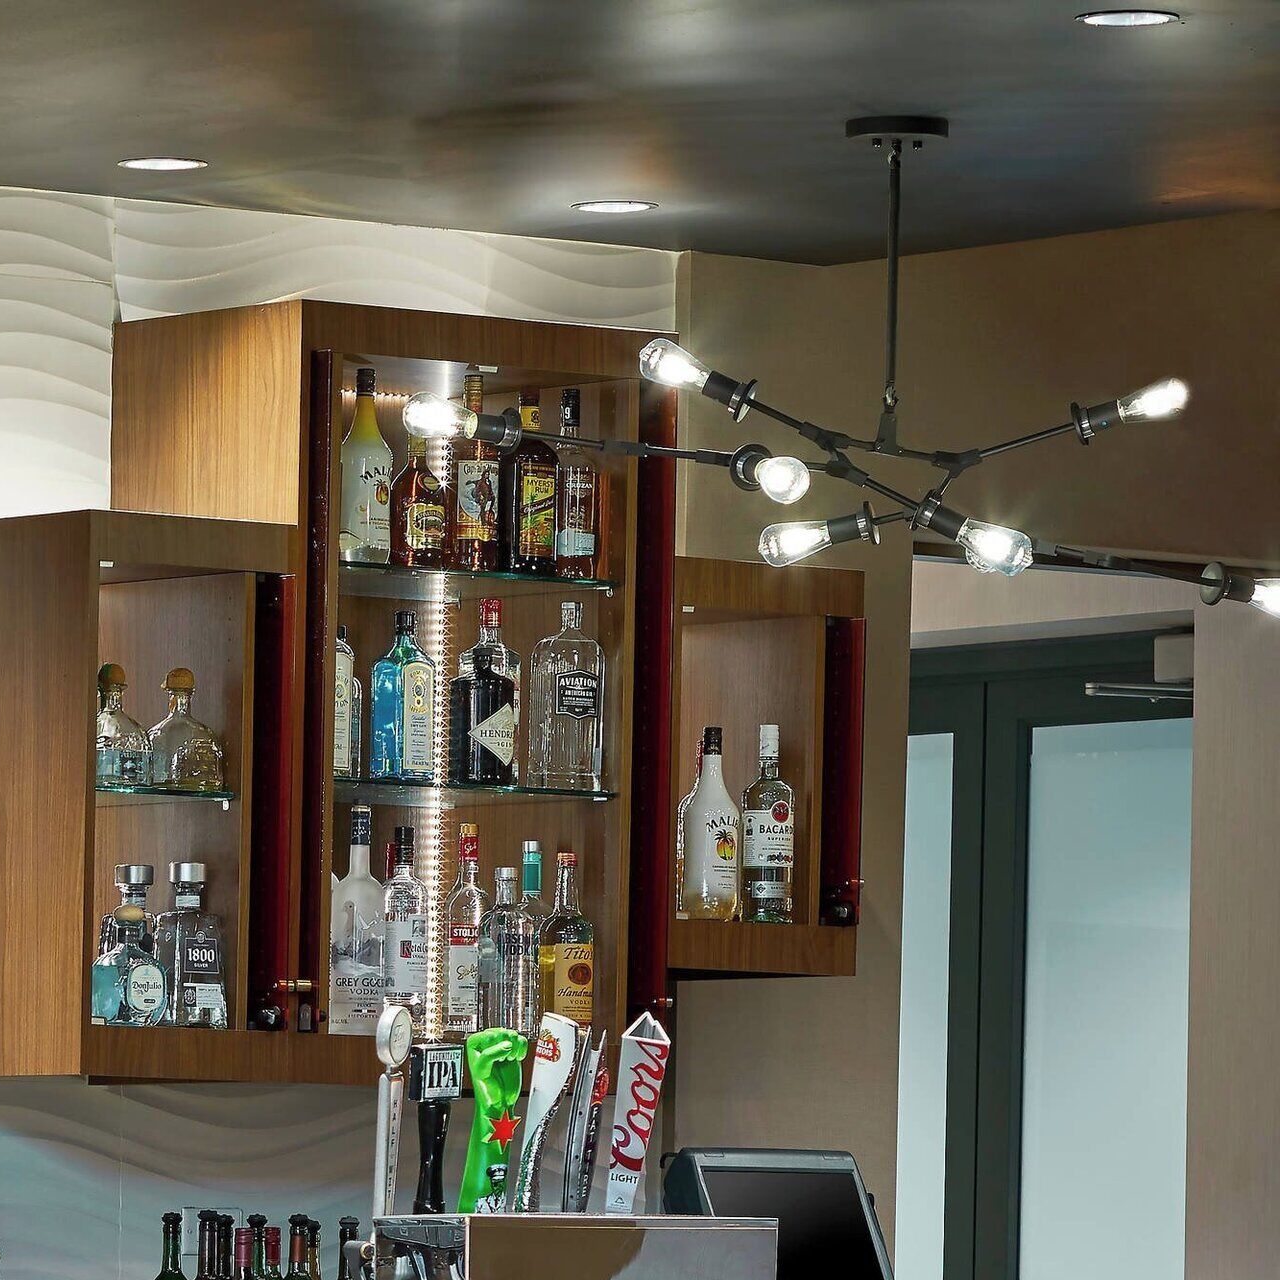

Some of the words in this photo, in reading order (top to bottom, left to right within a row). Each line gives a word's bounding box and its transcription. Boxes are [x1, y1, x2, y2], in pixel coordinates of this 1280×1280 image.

[559, 677, 597, 688] AVIATION
[187, 948, 215, 963] 1800
[335, 978, 359, 987] GREY
[427, 1060, 459, 1088] IPA
[609, 1040, 670, 1172] Coors
[610, 1172, 638, 1184] LIGHT
